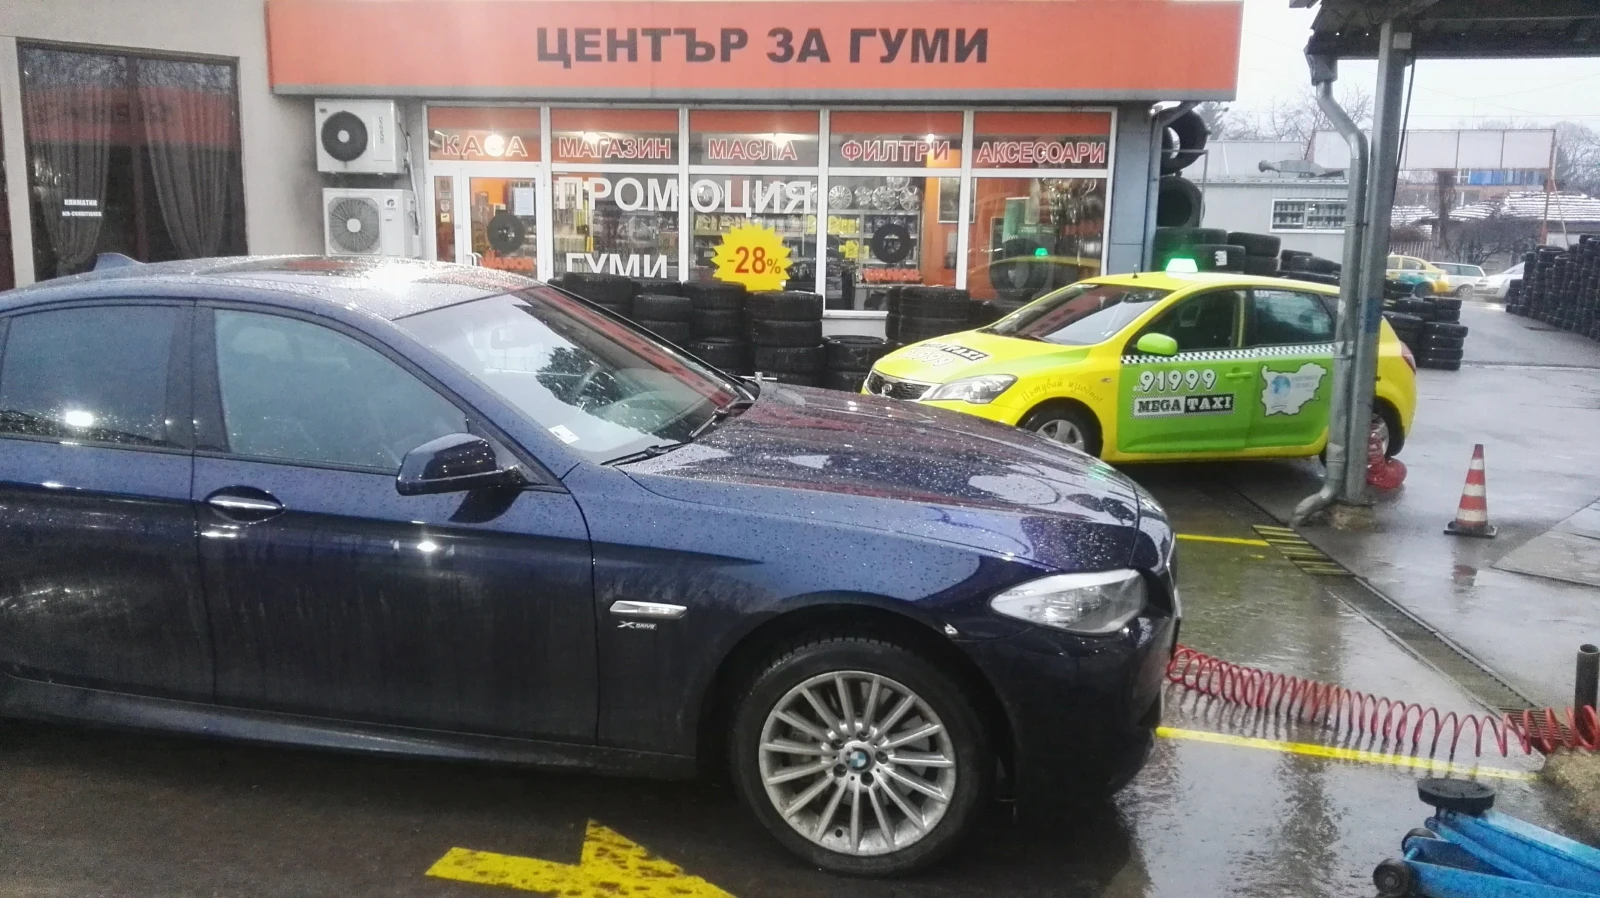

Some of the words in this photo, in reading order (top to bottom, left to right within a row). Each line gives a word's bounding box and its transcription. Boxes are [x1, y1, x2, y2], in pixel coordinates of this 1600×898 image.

[537, 27, 748, 69] ЦЕНТЪР
[766, 27, 831, 63] ЗА
[849, 28, 988, 63] ГУМИ
[442, 134, 529, 157] КАСА
[558, 136, 672, 160] МАГАЗИН
[708, 138, 798, 161] МАСЛА
[841, 140, 951, 162] ФИЛТРИ
[976, 141, 1106, 164] АКСЕСОАРИ
[558, 176, 812, 218] ПРОМОЦИЯ
[566, 252, 668, 279] ГУМИ
[726, 245, 782, 275] -28%
[1139, 368, 1216, 393] 91999
[1137, 399, 1182, 413] MEGA
[1186, 396, 1232, 411] TAXI
